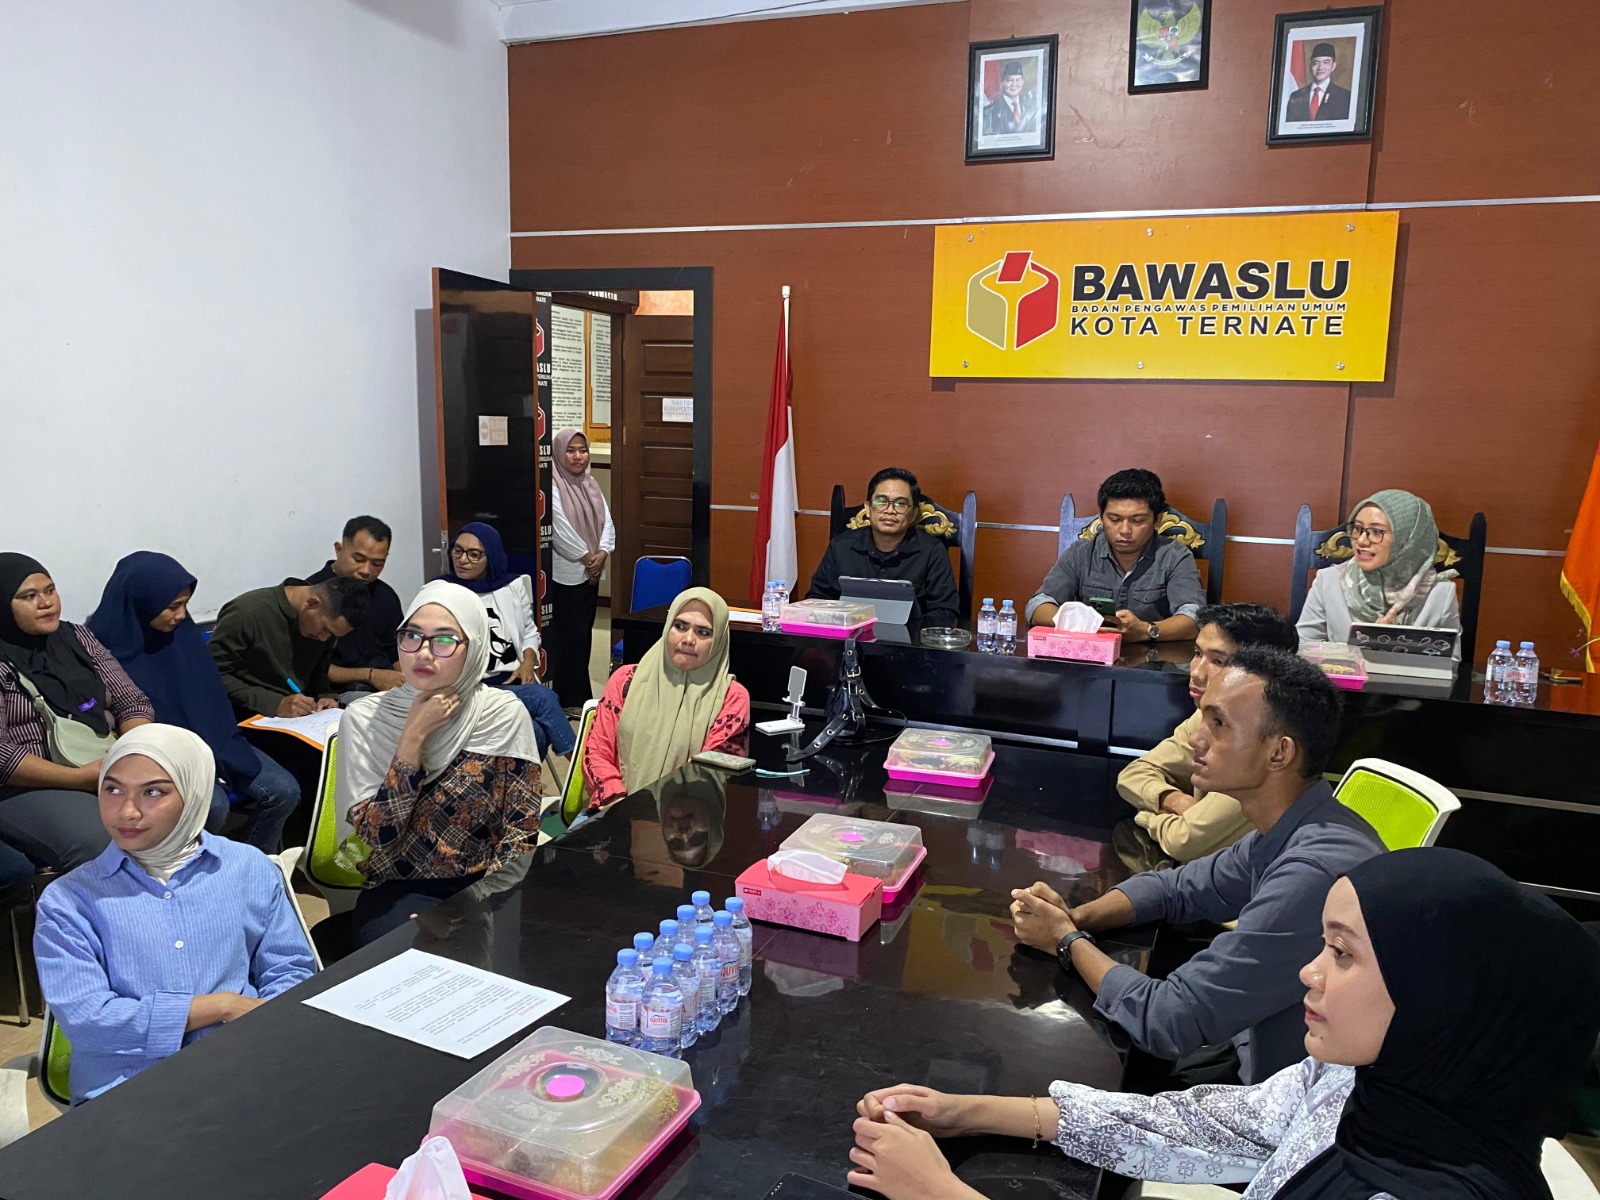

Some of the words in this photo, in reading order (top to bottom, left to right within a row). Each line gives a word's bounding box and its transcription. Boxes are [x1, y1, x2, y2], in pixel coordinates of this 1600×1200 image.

[1072, 260, 1350, 301] BAWASLU
[1071, 305, 1120, 313] BADAN
[1125, 304, 1206, 313] PENGAWAS
[1212, 303, 1297, 312] PEMILIHAN
[1302, 303, 1346, 311] UMUM
[1071, 316, 1158, 336] KOTA
[1176, 315, 1343, 336] TERNATE
